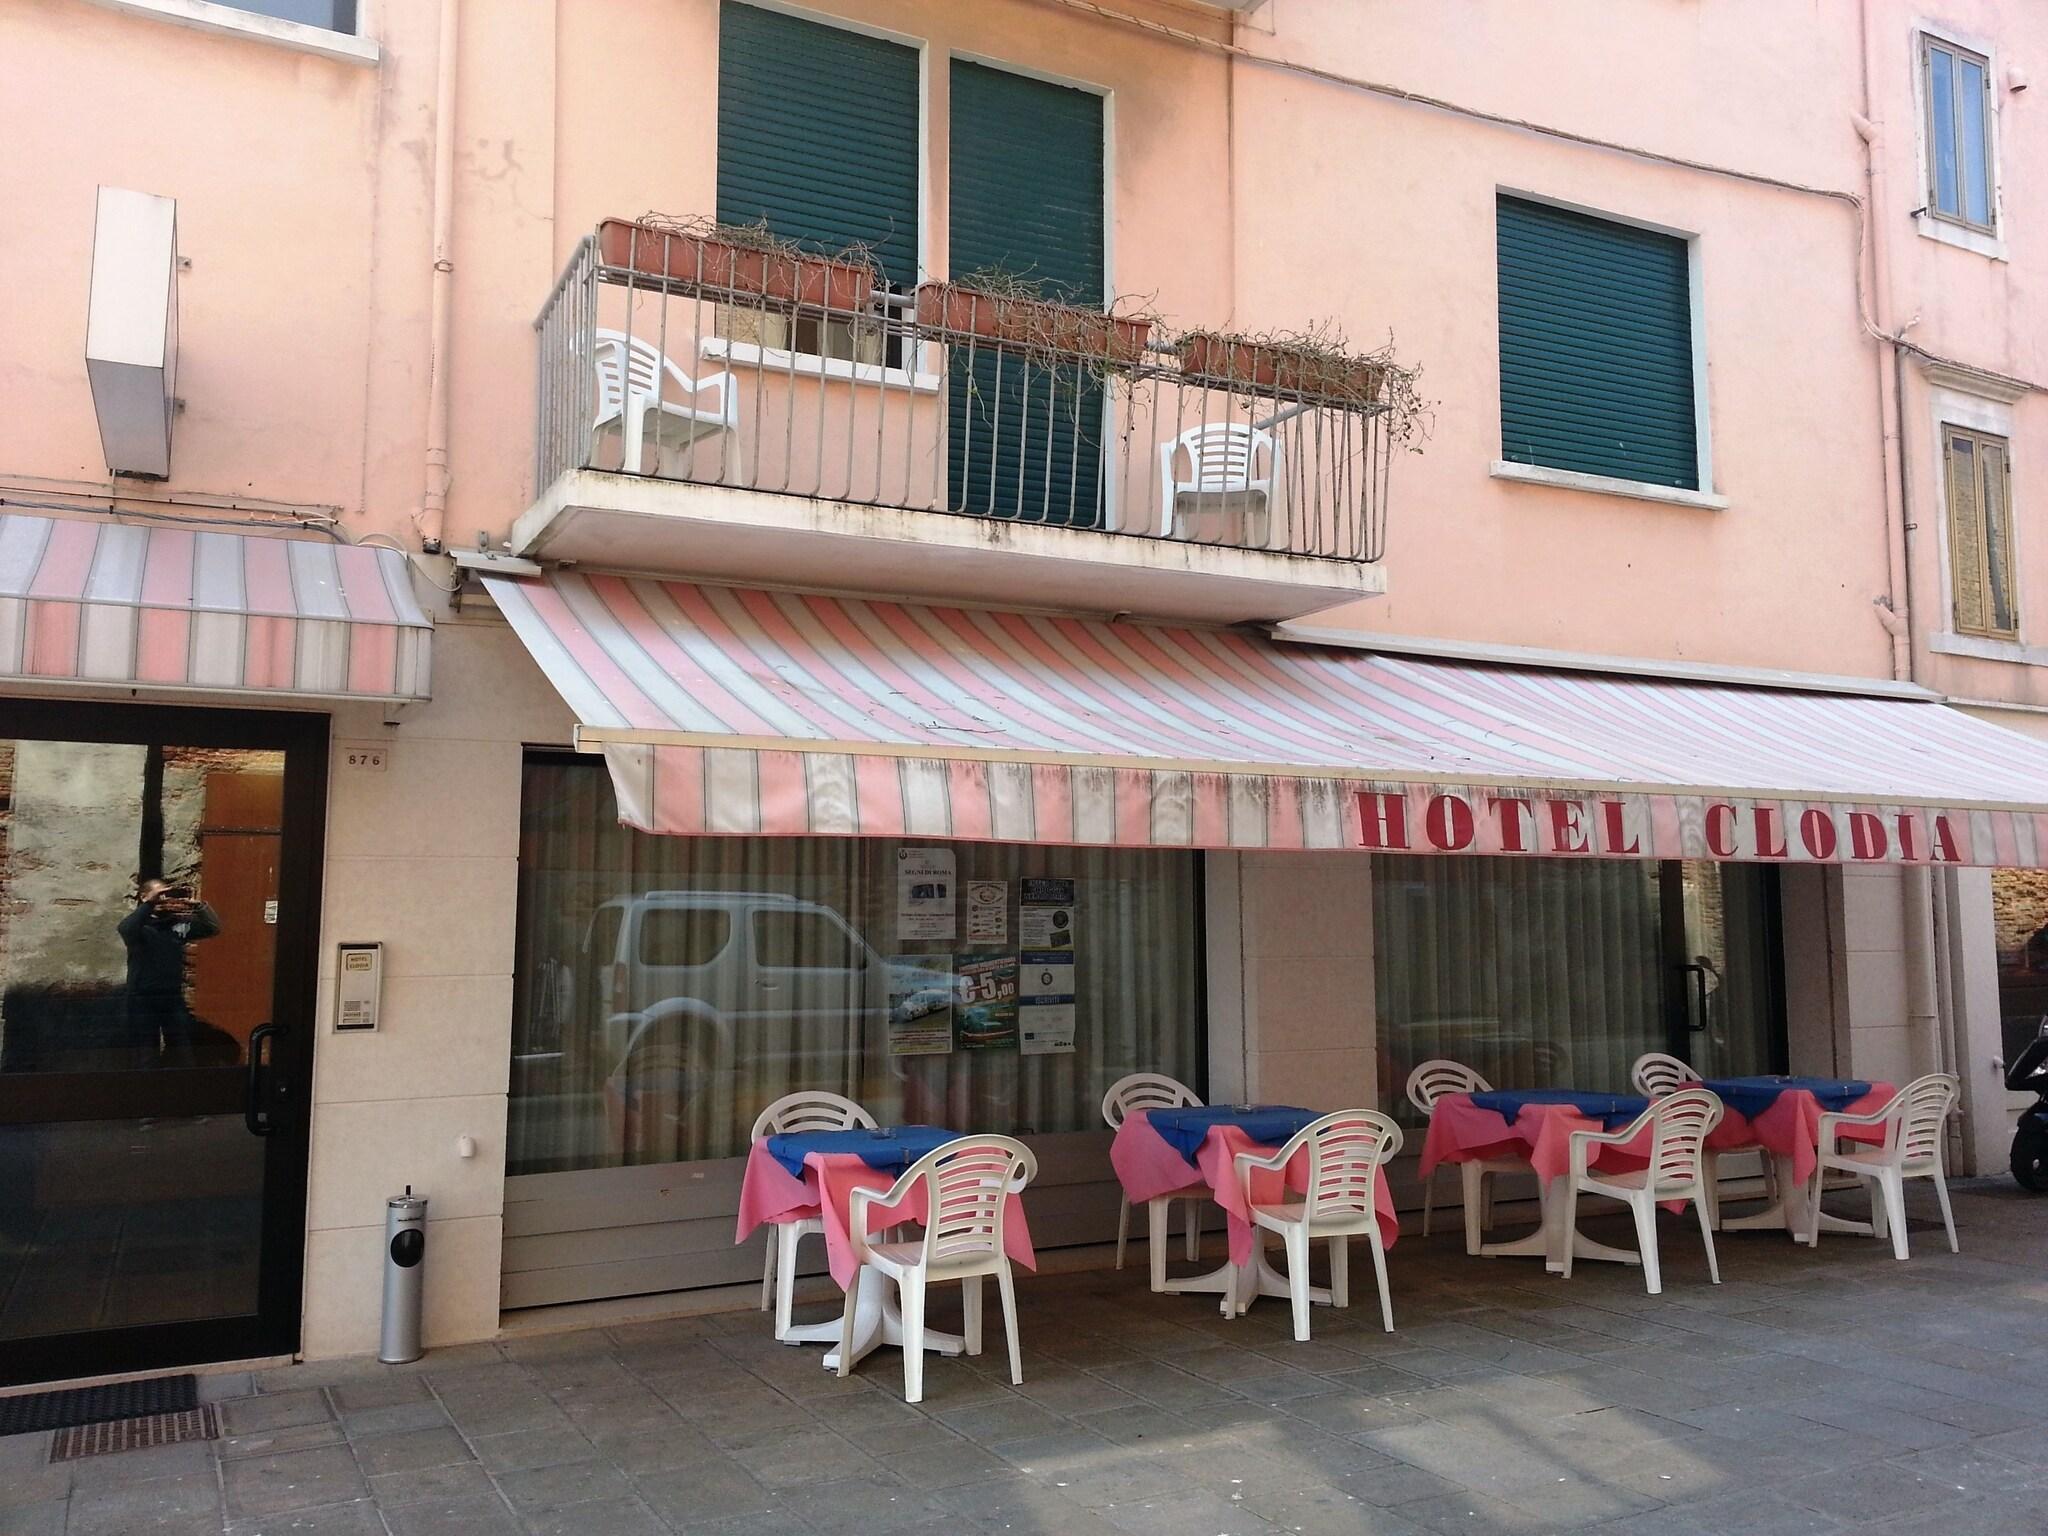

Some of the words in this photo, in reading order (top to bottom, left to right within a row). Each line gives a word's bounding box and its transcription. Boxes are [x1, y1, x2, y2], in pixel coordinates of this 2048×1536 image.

[349, 754, 380, 766] 876
[1353, 790, 1640, 854] HOTEL
[1705, 795, 1962, 862] CLODIA
